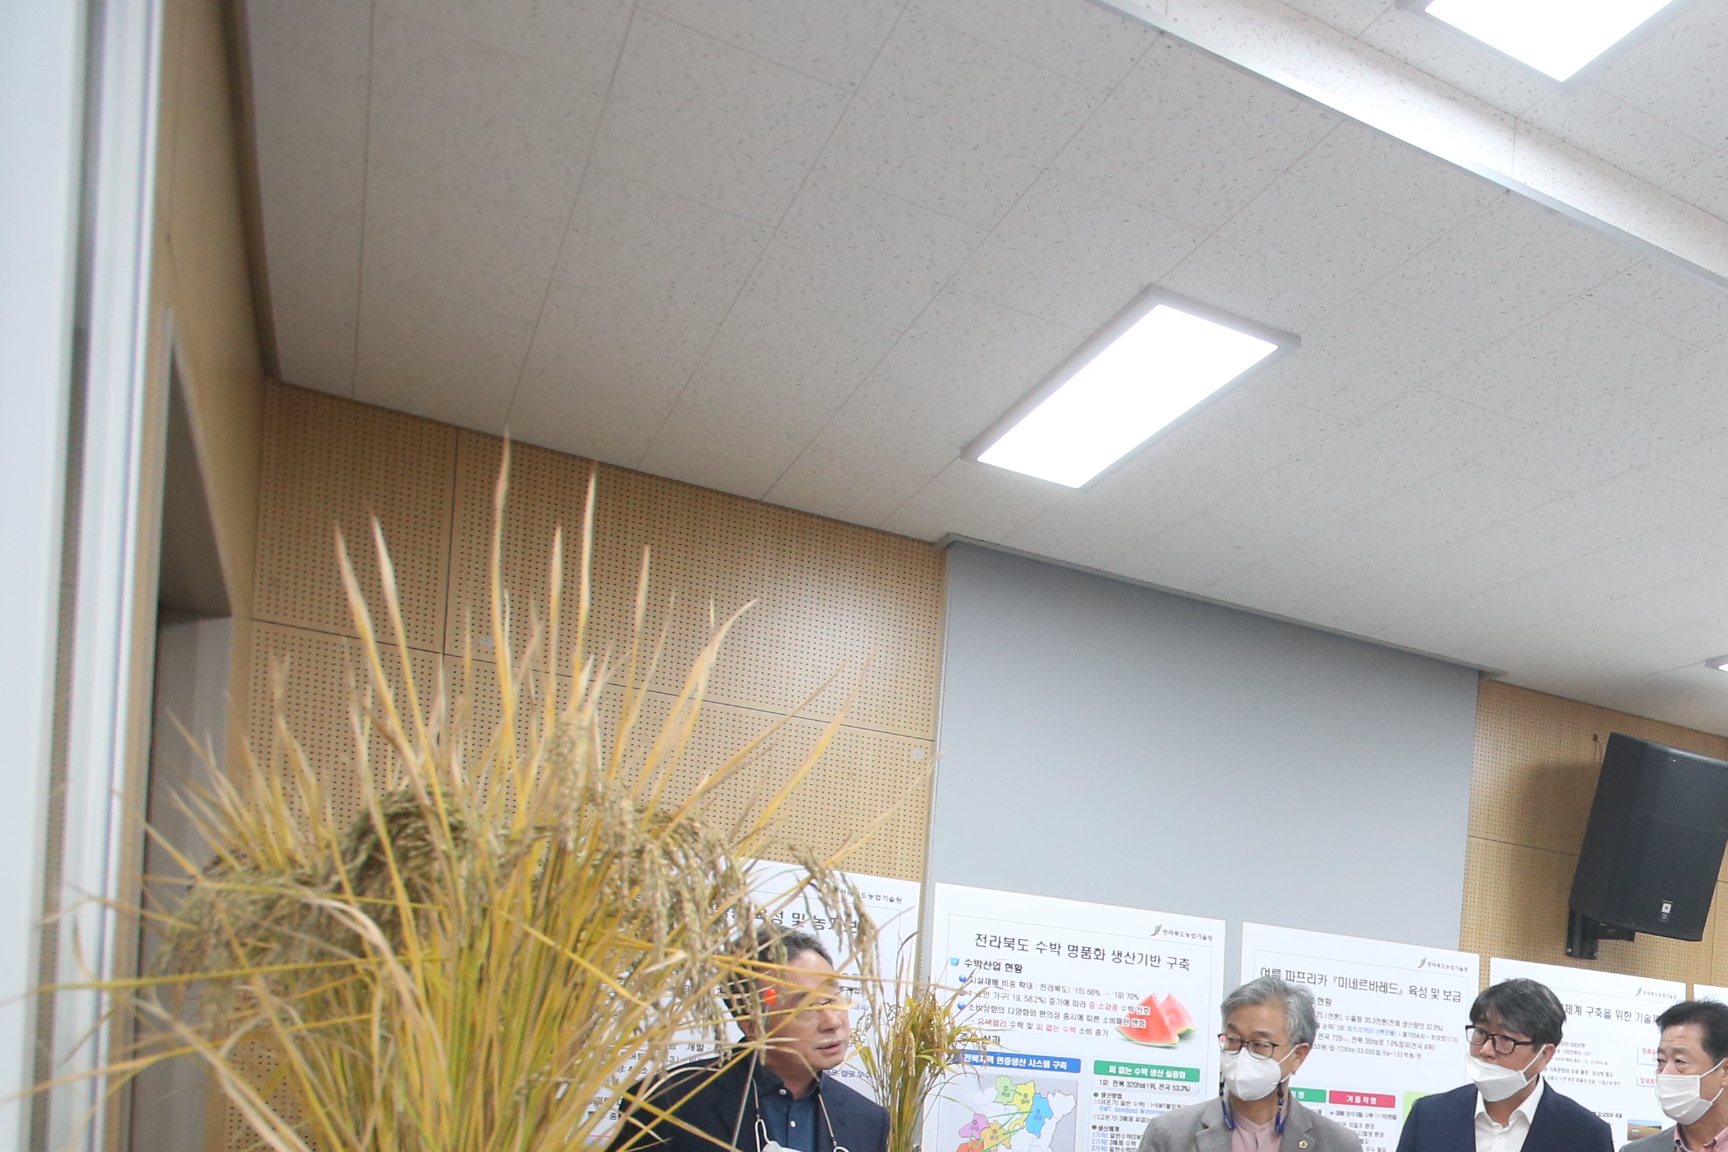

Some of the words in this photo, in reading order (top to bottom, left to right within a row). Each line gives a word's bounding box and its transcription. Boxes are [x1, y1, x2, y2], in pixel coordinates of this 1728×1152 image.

[791, 912, 805, 928] 및
[1163, 928, 1213, 942] 전라북도농업기술원
[975, 933, 1029, 952] 전라북도
[1035, 940, 1062, 956] 수박
[1067, 944, 1106, 961] 명품화
[1111, 949, 1161, 968] 생산기반
[1166, 956, 1190, 972] 구축
[964, 958, 1001, 971] 수박산업
[1005, 963, 1023, 974] 현황
[1002, 979, 1016, 989] 비중
[1285, 970, 1328, 986] 파프리카
[1409, 984, 1428, 999] 육성
[1431, 987, 1441, 1000] 및
[1443, 990, 1462, 1003] 보급
[1072, 1000, 1087, 1008] 따라
[1121, 1005, 1134, 1013] 수박
[1317, 997, 1332, 1007] 현황
[1040, 1010, 1061, 1020] 편의성
[1586, 1005, 1611, 1020] 구축을
[1615, 1009, 1633, 1022] 위한
[1009, 1021, 1024, 1030] 수박
[1062, 1026, 1077, 1034] 수박
[1079, 1027, 1093, 1036] 소비
[996, 1056, 1026, 1067] 연중생산
[1028, 1060, 1050, 1069] 시스템
[1052, 1062, 1067, 1070] 구축
[1118, 1066, 1132, 1075] 없는
[1134, 1068, 1148, 1077] 수박
[1149, 1069, 1164, 1078] 생산
